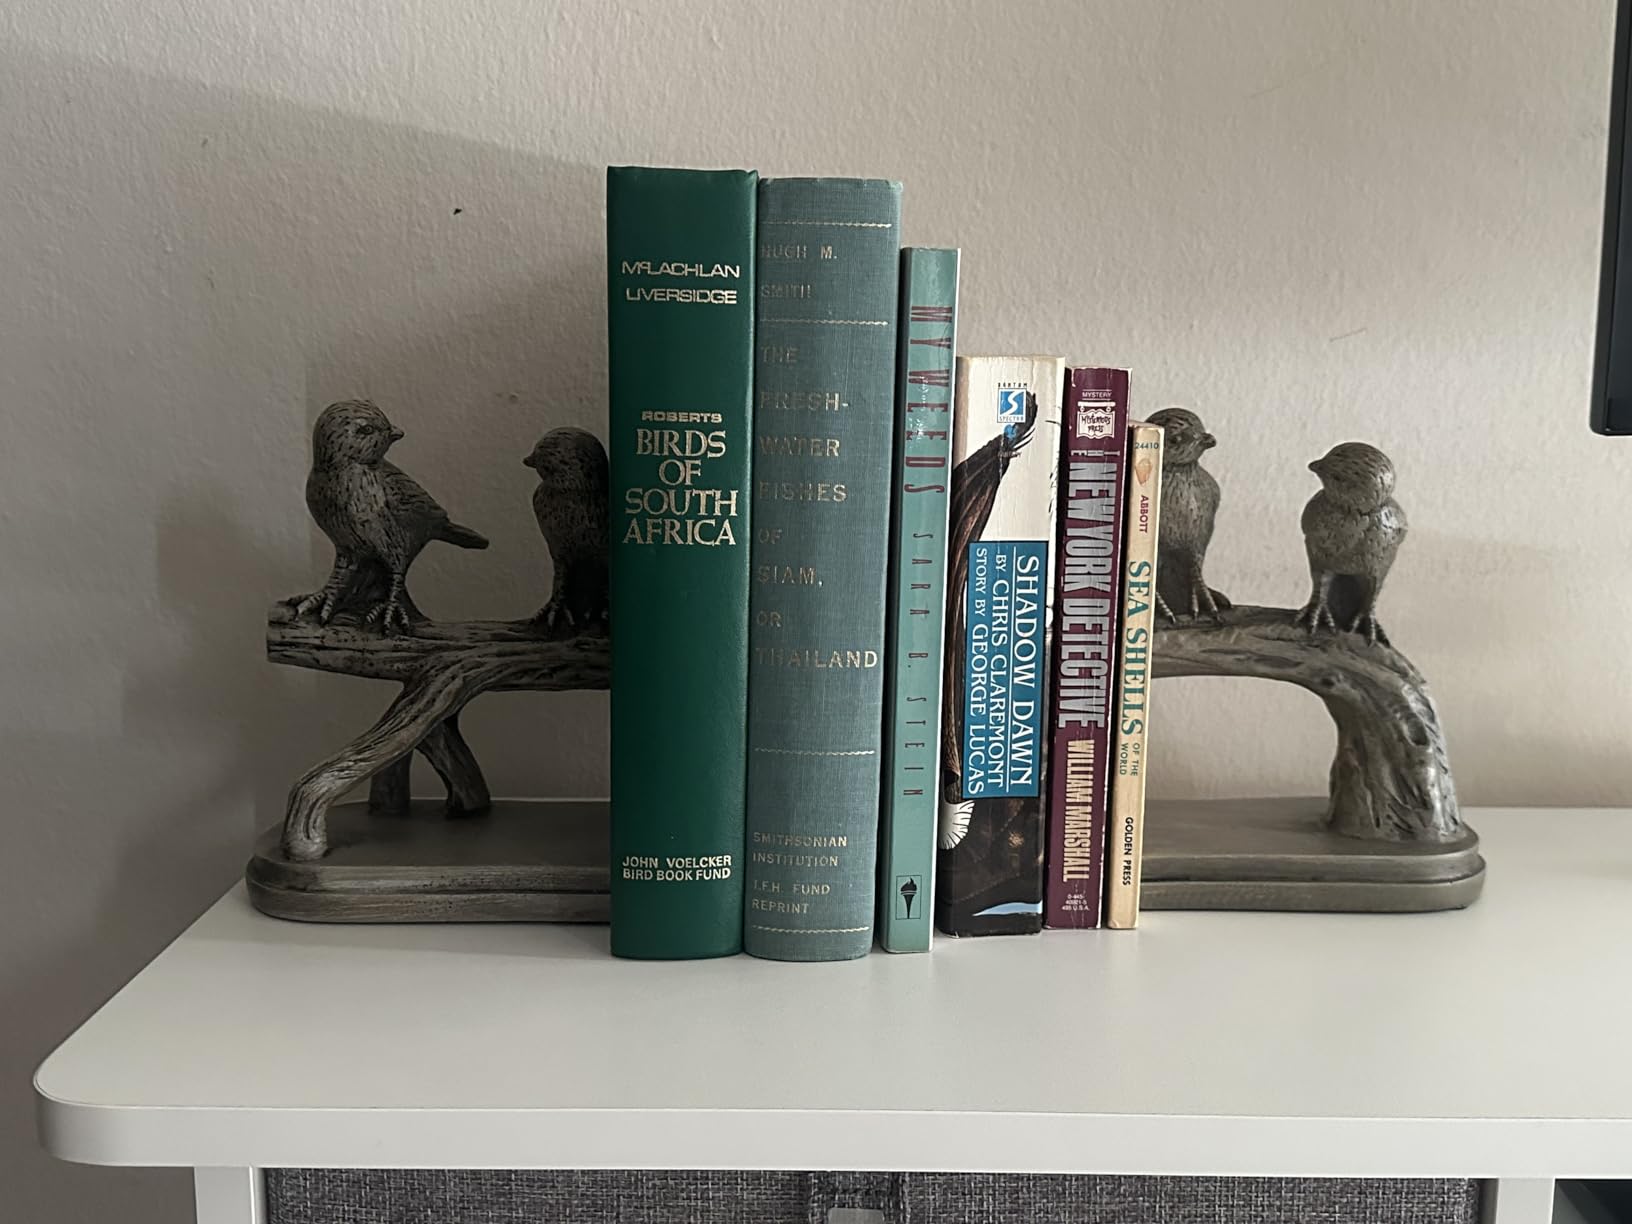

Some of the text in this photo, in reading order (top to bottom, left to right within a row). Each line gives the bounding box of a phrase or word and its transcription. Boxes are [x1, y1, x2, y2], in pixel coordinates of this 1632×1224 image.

[760, 245, 838, 259] HUGH M.
[621, 261, 740, 278] McLACHLAN
[626, 287, 738, 304] LIVERSIDGE
[760, 284, 812, 299] SMITH
[760, 345, 800, 363] THE
[641, 410, 723, 423] ROBERTS
[636, 428, 727, 459] BIRDS
[904, 368, 950, 493] WEEDS
[758, 435, 840, 457] WATER
[1135, 442, 1159, 450] 24410
[658, 459, 702, 486] OF
[625, 487, 739, 517] SOUTH
[758, 481, 848, 502] FISHES
[1067, 462, 1117, 523] NEW
[1138, 494, 1150, 534] ABBOTT
[622, 517, 736, 546] AFRICA
[758, 527, 783, 545] OF
[1063, 524, 1114, 593] YORK
[909, 532, 934, 616] SARA
[756, 611, 782, 628] OR
[755, 648, 878, 669] THAILAND
[1121, 560, 1152, 735] SEA SHELLS
[967, 547, 989, 795] STORY BY GEORGE LUCAS
[987, 554, 1010, 788] BY CHRIS CLAREMONT
[1010, 555, 1040, 785] SHADOW DAWN
[1058, 598, 1110, 728] DETECTIVE
[903, 696, 928, 796] STEIN
[1119, 742, 1129, 776] WORLD
[1130, 742, 1141, 777] OF THE
[1062, 739, 1095, 882] WILLIAM MARSHALL
[752, 832, 848, 847] SMITHSONIAN
[1122, 816, 1134, 886] GOLDEN PRESS
[622, 855, 732, 869] JOHN VOELCKER
[752, 852, 839, 867] INSTITUTION
[622, 867, 731, 881] BIRD BOOK FUND
[791, 883, 831, 896] FUND
[751, 899, 810, 914] REPRINT
